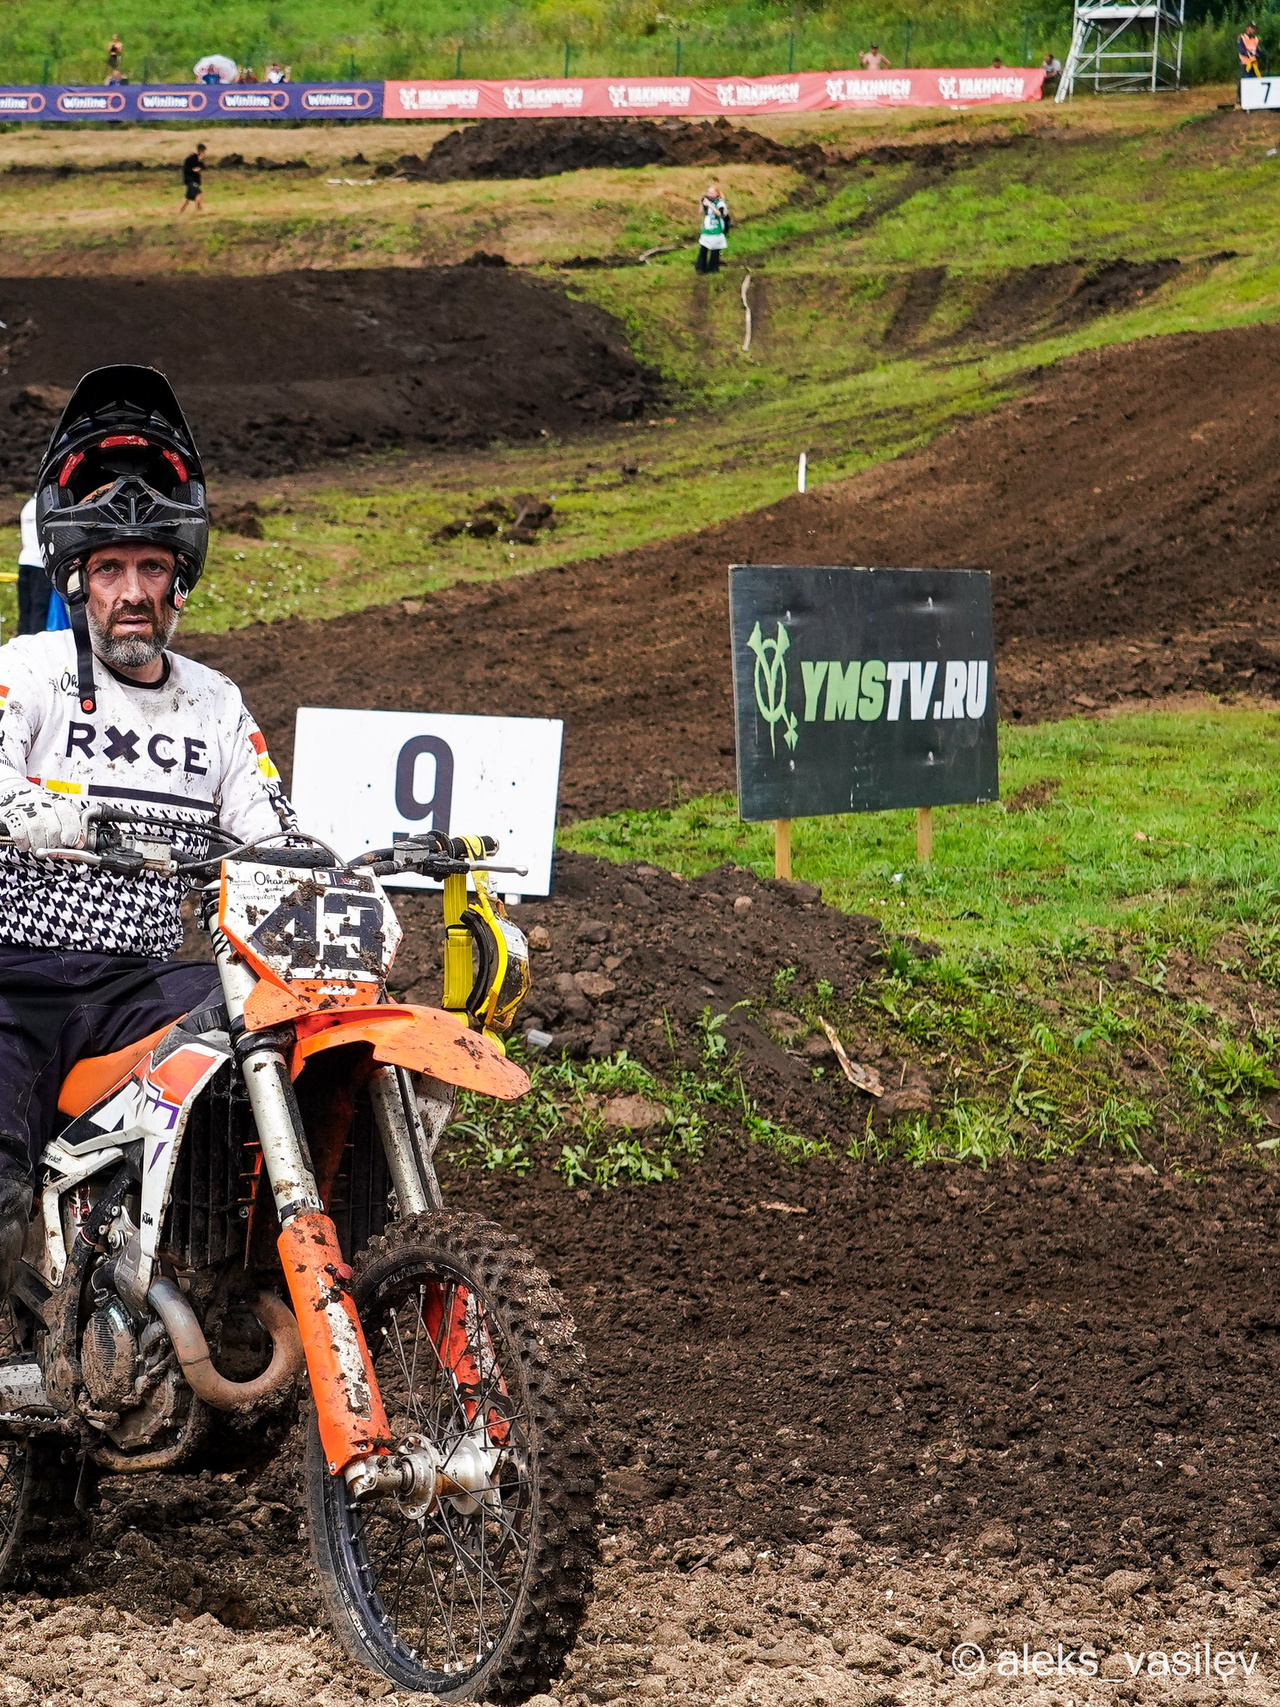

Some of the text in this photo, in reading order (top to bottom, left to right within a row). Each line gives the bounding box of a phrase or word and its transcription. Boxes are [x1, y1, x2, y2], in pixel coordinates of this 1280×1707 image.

[846, 78, 911, 96] YAKHNICH
[959, 77, 1025, 95] YAKHNICH
[1261, 82, 1271, 104] 7
[62, 96, 107, 109] Winline
[142, 95, 188, 108] Winline
[224, 94, 270, 107] Winline
[307, 93, 353, 106] Winline
[800, 659, 989, 722] YMSTV.RU
[392, 734, 455, 840] 9
[250, 891, 384, 972] 43
